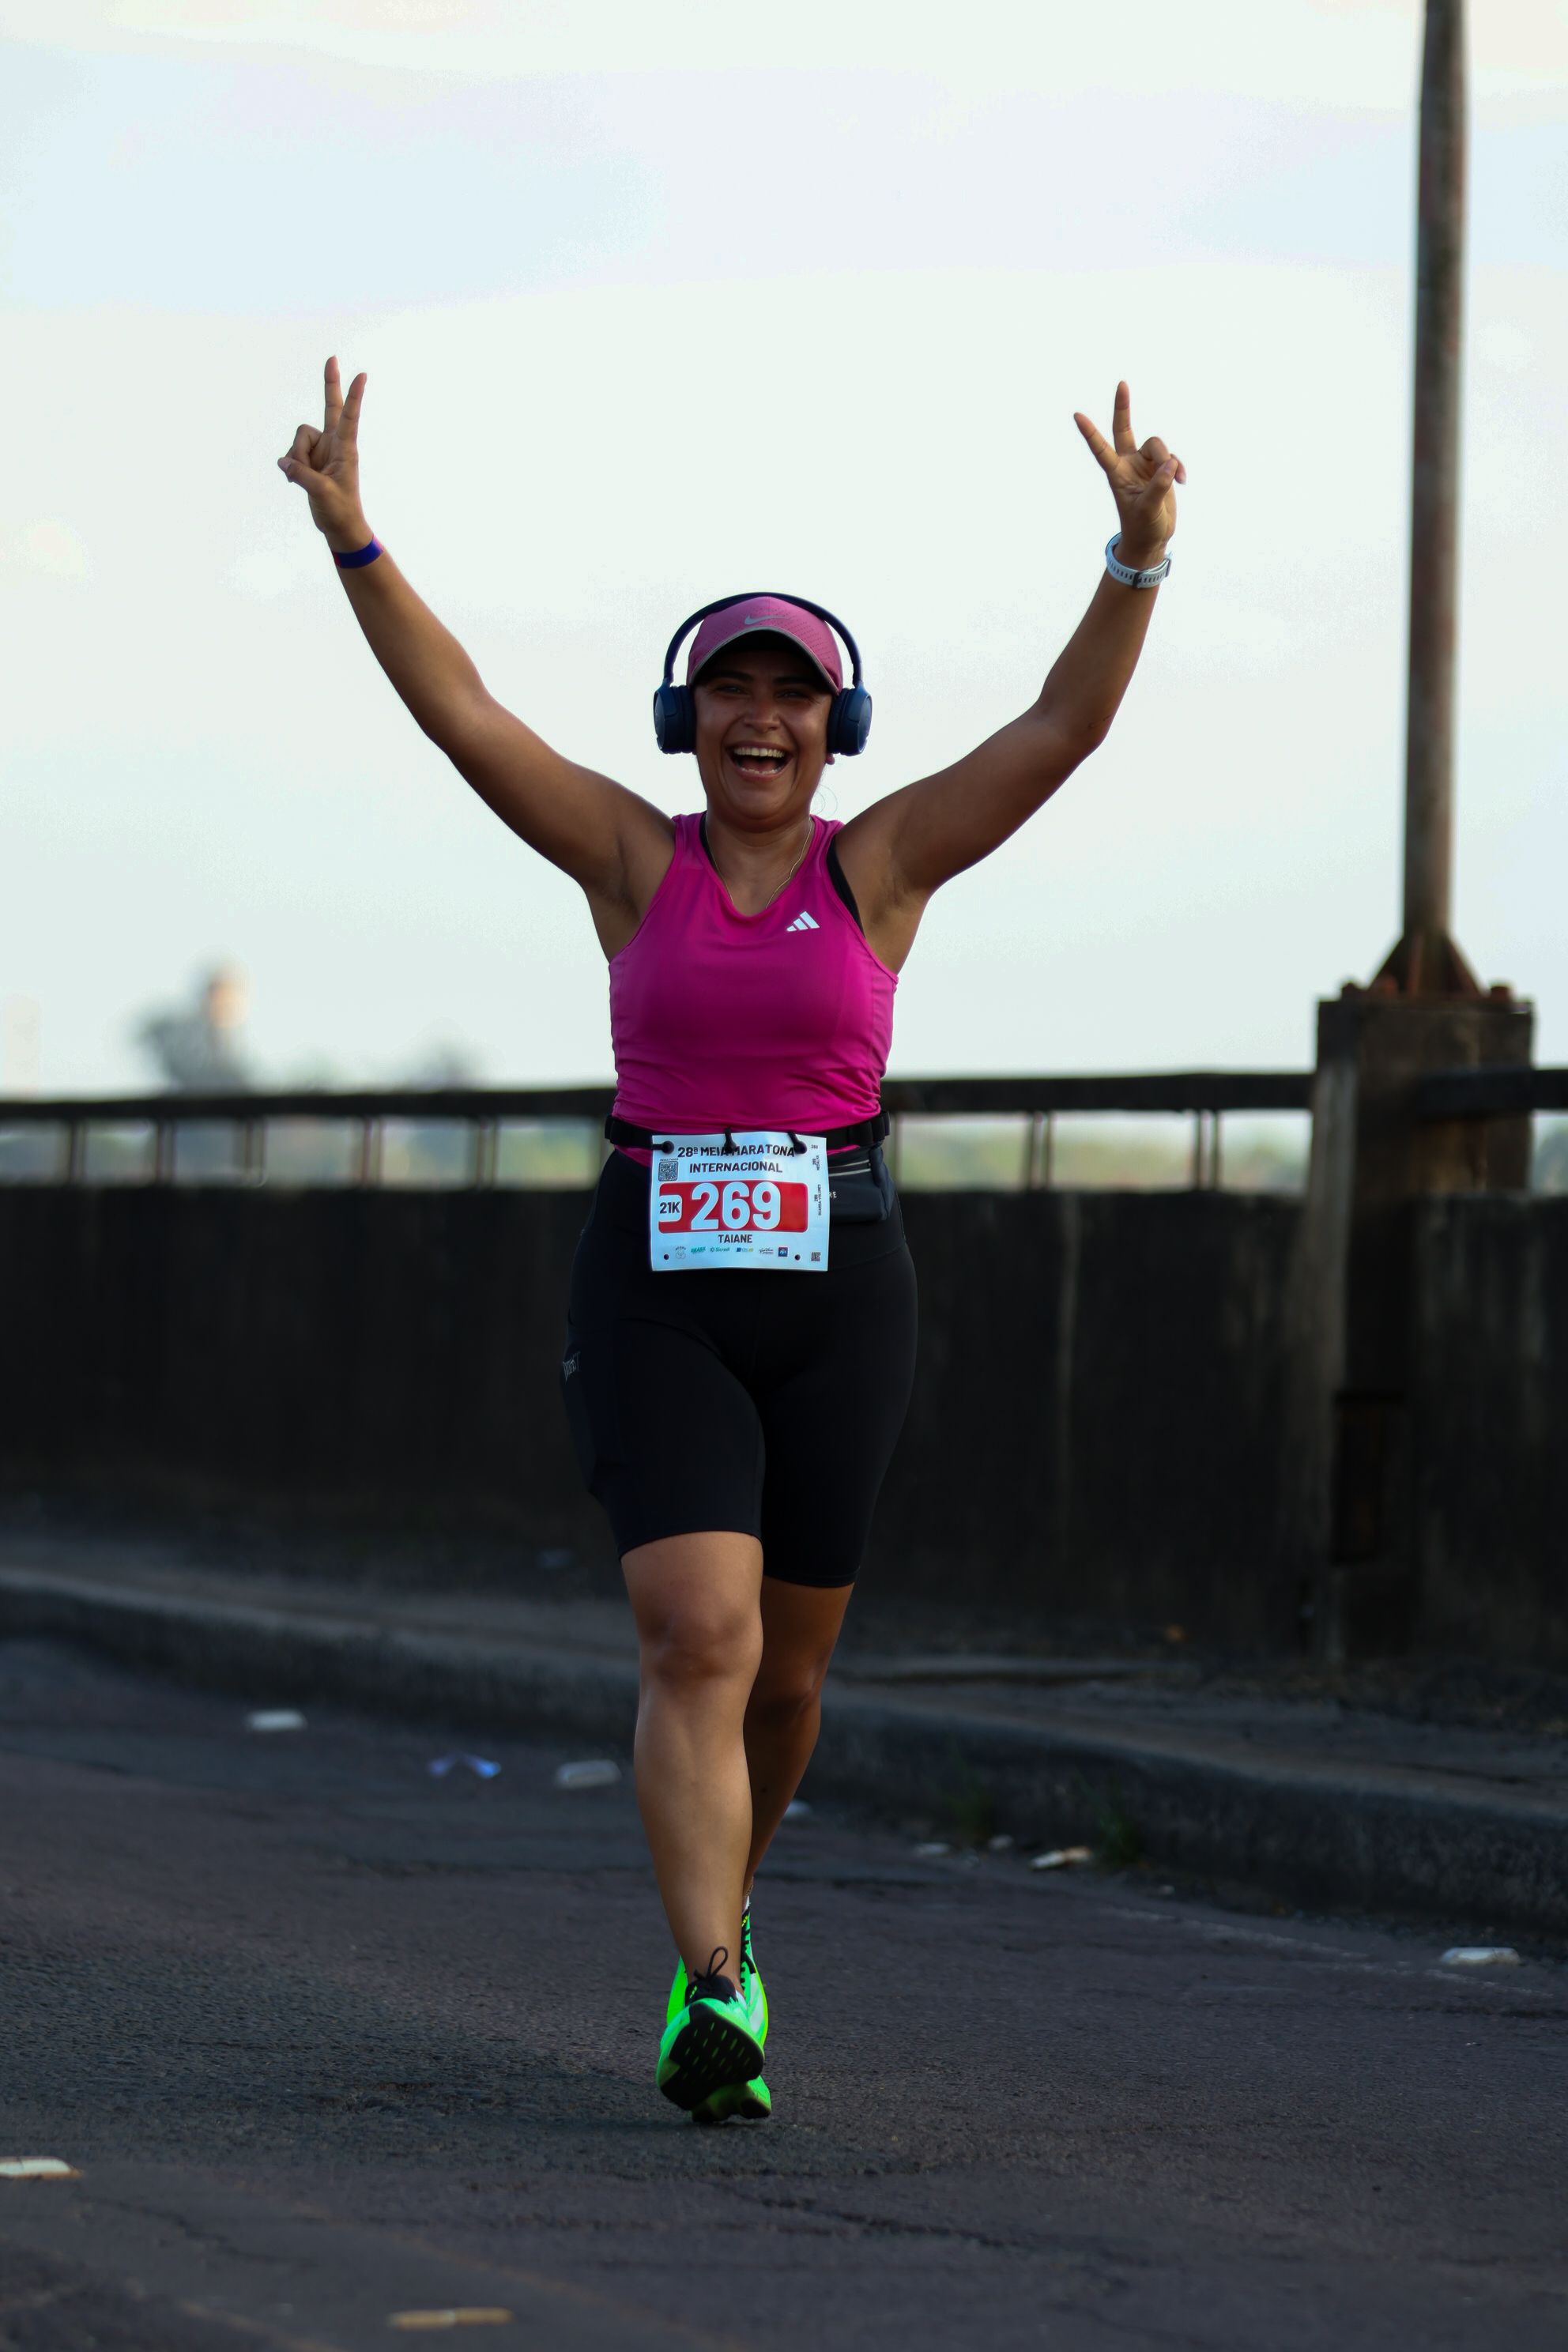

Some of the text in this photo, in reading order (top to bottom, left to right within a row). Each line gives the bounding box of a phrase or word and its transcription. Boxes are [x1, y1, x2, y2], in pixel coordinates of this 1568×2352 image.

[677, 1147, 699, 1157] 28ª
[701, 1146, 728, 1156] MEIA
[690, 1161, 782, 1173] INTERNACIONAL
[659, 1202, 680, 1214] 21K
[691, 1182, 781, 1230] 269
[718, 1234, 752, 1243] TAIANE
